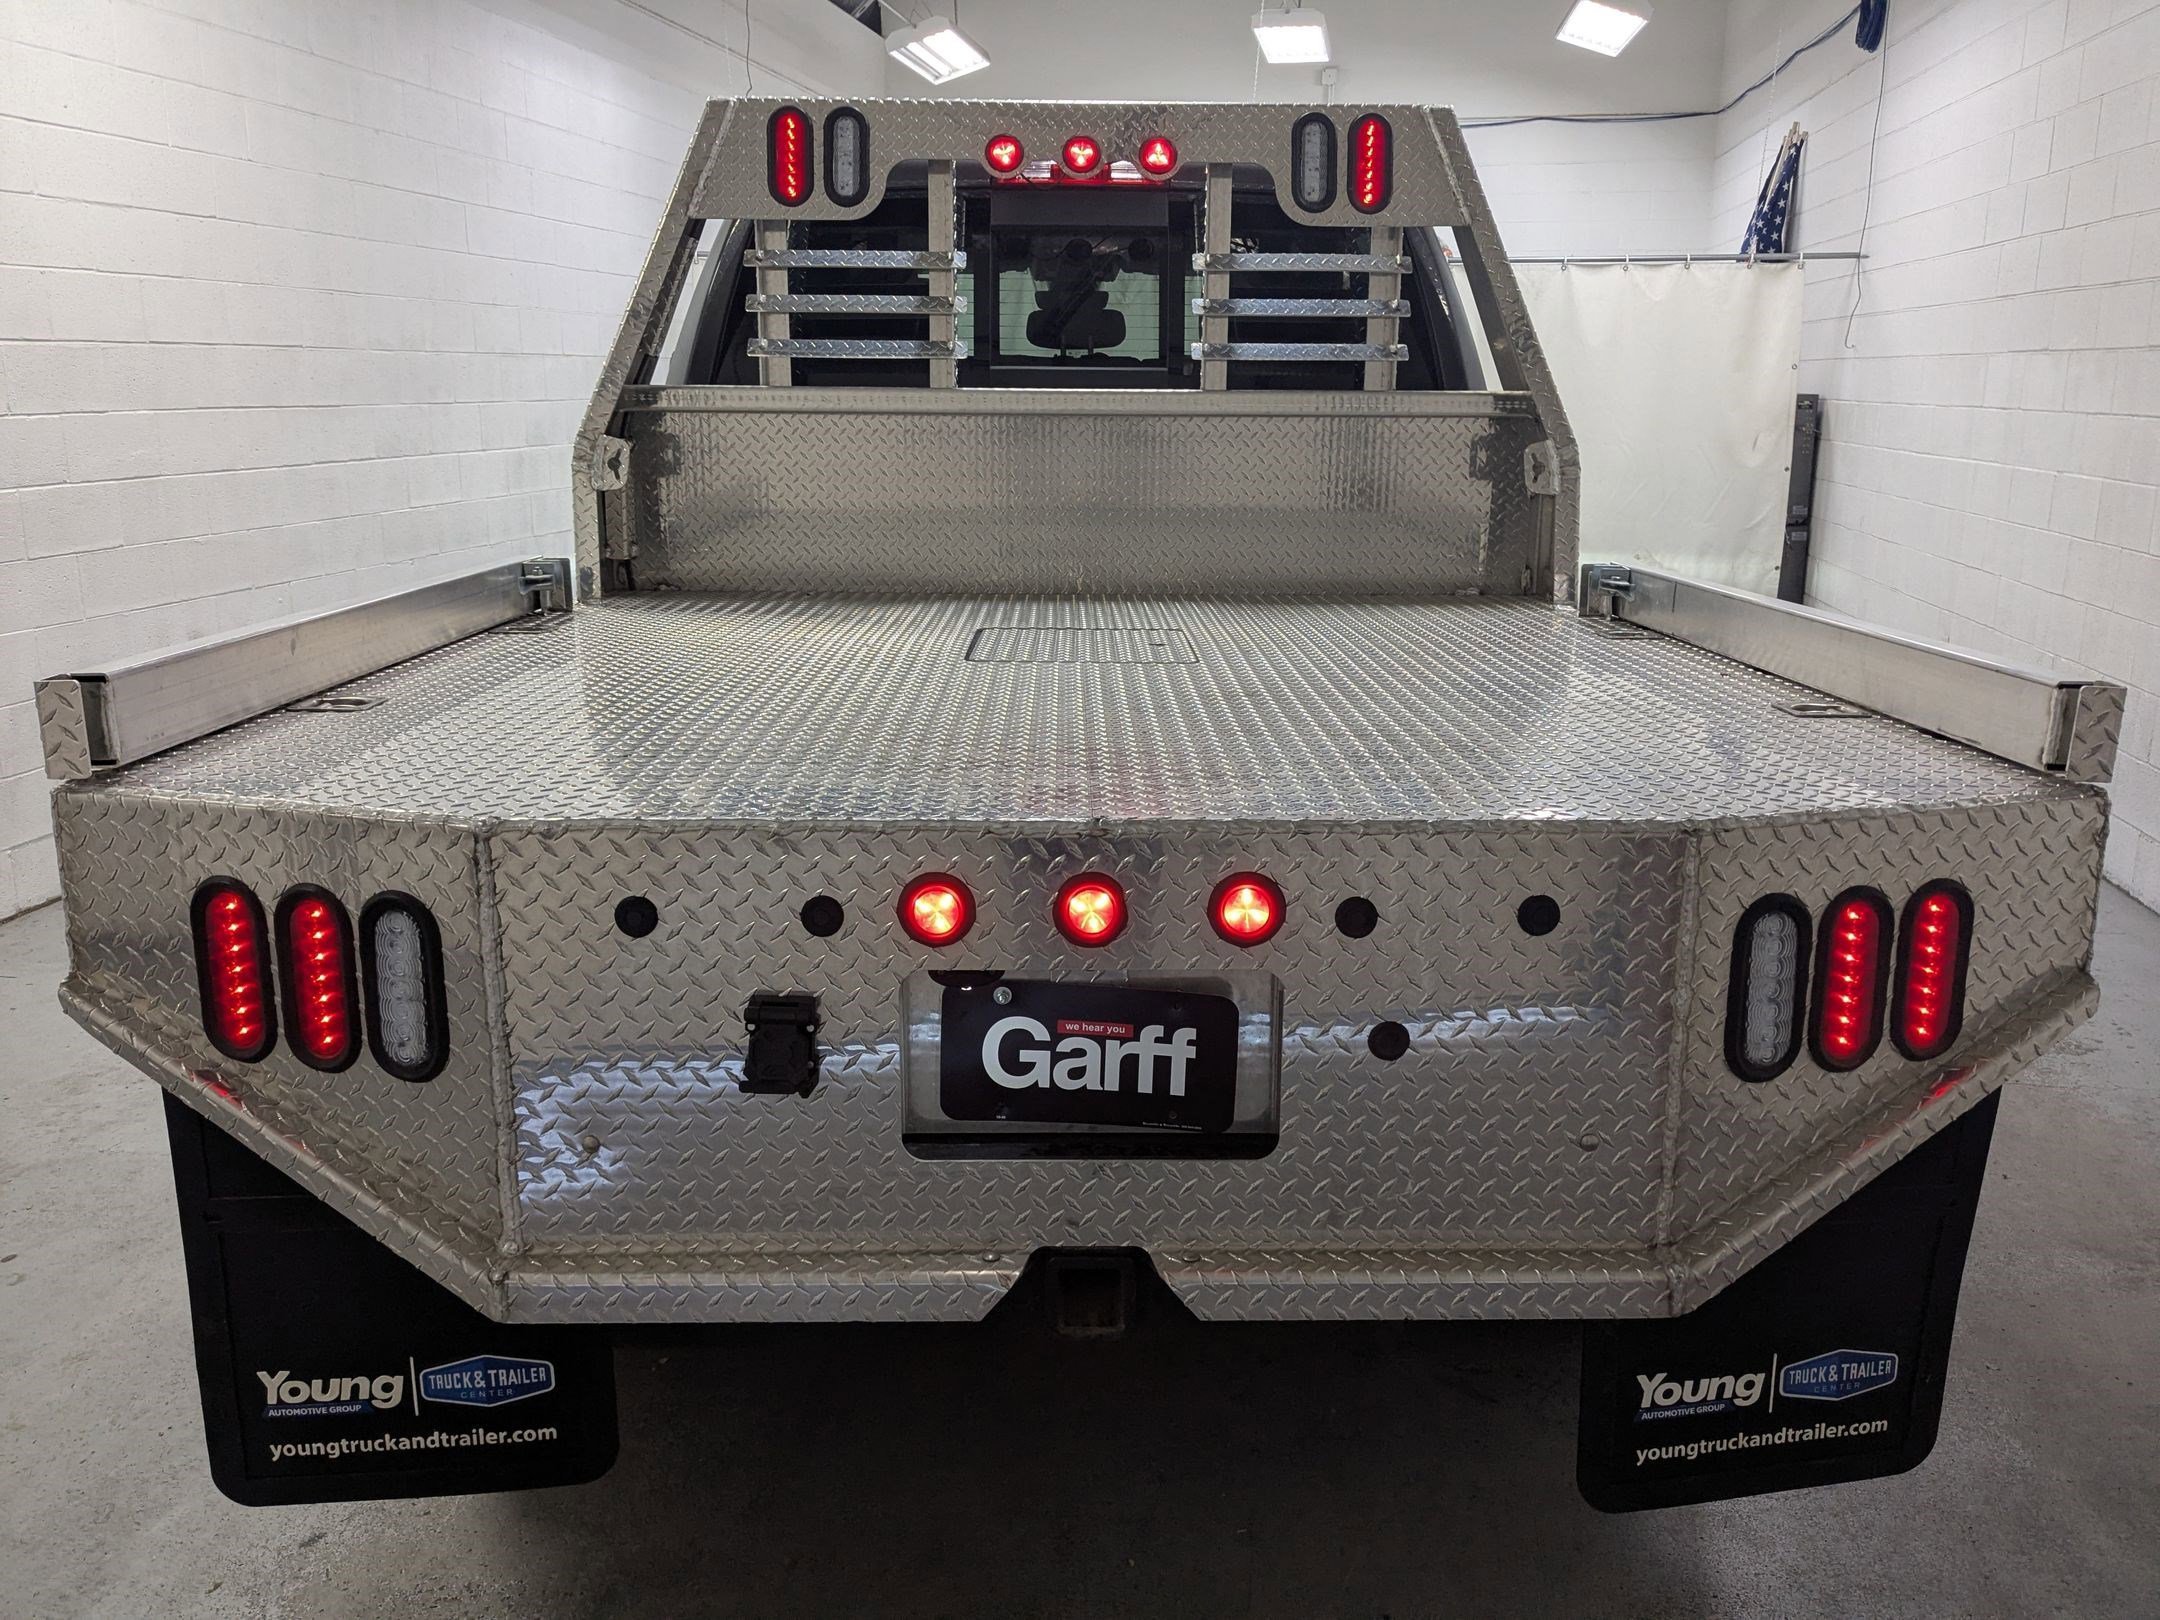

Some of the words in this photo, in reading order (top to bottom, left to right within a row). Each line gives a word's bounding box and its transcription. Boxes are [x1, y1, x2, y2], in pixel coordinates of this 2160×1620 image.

[1065, 1023, 1080, 1031] we
[1082, 1022, 1105, 1032] hear
[1106, 1026, 1126, 1035] you
[982, 1016, 1197, 1097] Garff
[429, 1371, 473, 1390] TRUCK
[487, 1367, 547, 1387] TRAILER
[1790, 1365, 1827, 1385] TRUCK
[1841, 1359, 1893, 1379] TRAILER
[256, 1370, 404, 1409] Young
[461, 1389, 514, 1399] CENTER
[1636, 1372, 1766, 1407] Young
[1814, 1382, 1861, 1393] CENTER
[268, 1406, 327, 1417] AUTOMOTIVE
[329, 1404, 362, 1413] GROUP
[1641, 1408, 1695, 1420] AUTOMOTIVE
[1696, 1404, 1726, 1414] GROUP
[270, 1427, 558, 1461] youngtruckandtrailer.com
[1636, 1420, 1888, 1466] youngtruckandtrailer.com
